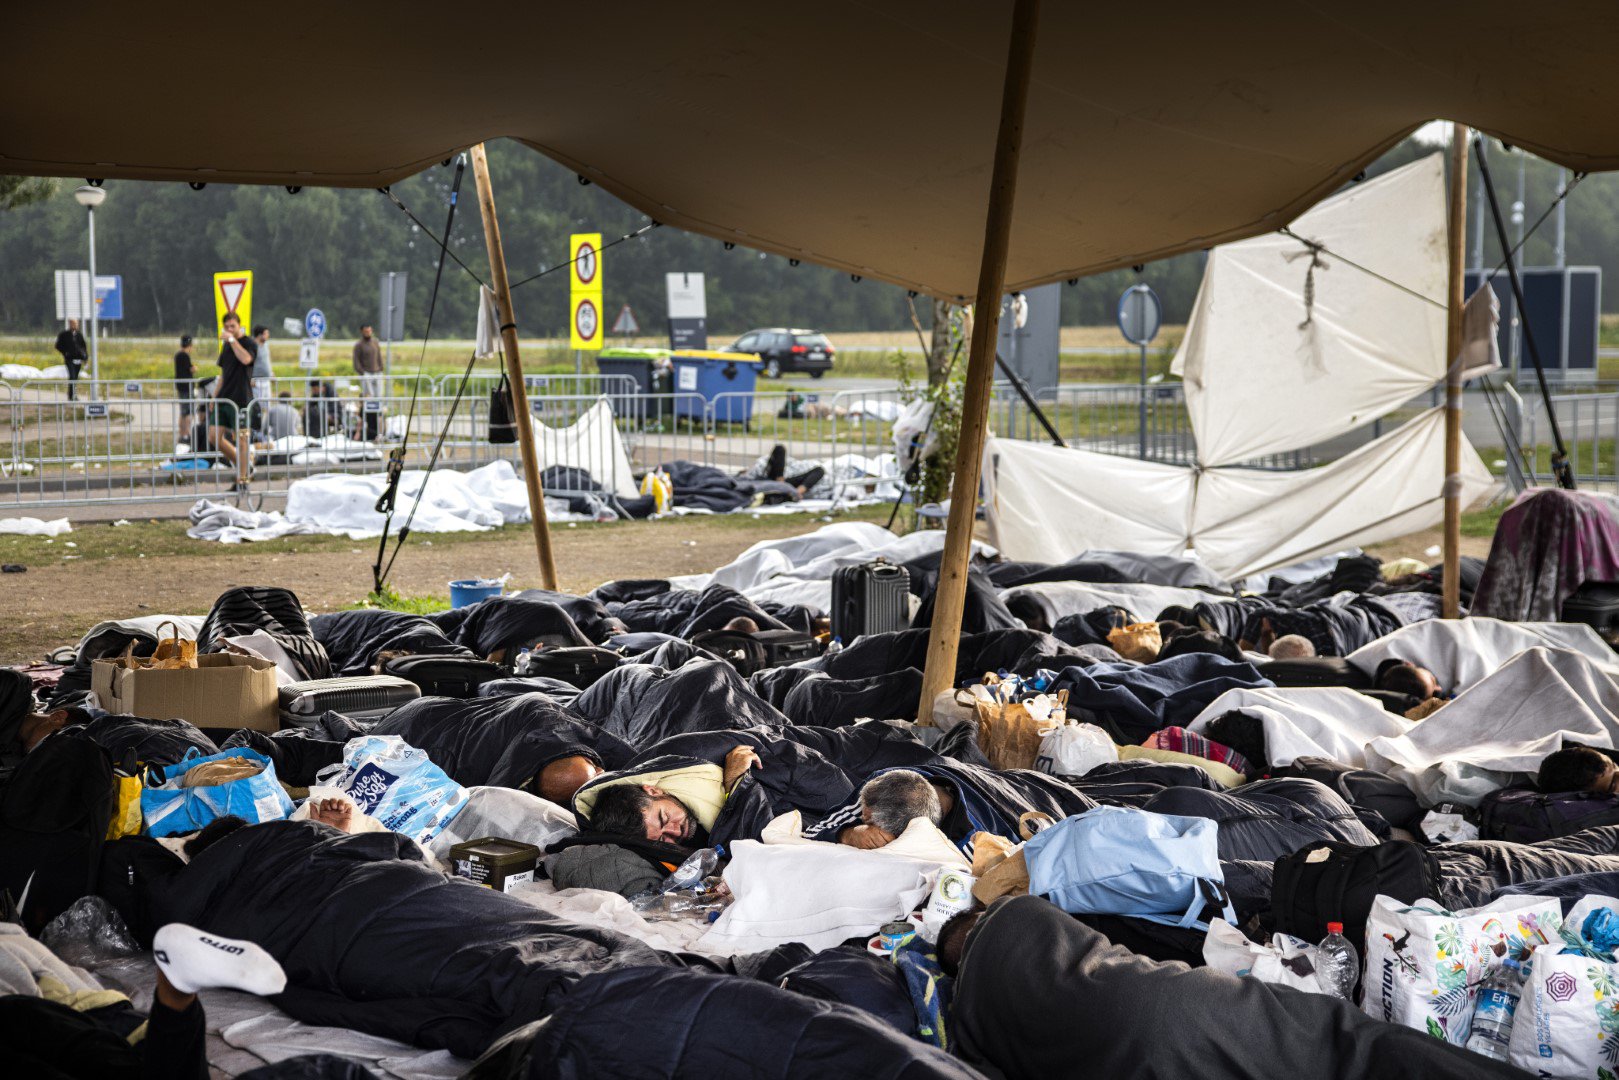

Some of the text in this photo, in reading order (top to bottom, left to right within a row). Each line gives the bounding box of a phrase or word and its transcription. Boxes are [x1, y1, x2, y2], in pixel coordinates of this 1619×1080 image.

[347, 775, 371, 800] Pure
[364, 771, 386, 802] Soft
[199, 936, 245, 955] LOTTO
[1382, 958, 1393, 1021] ACTION
